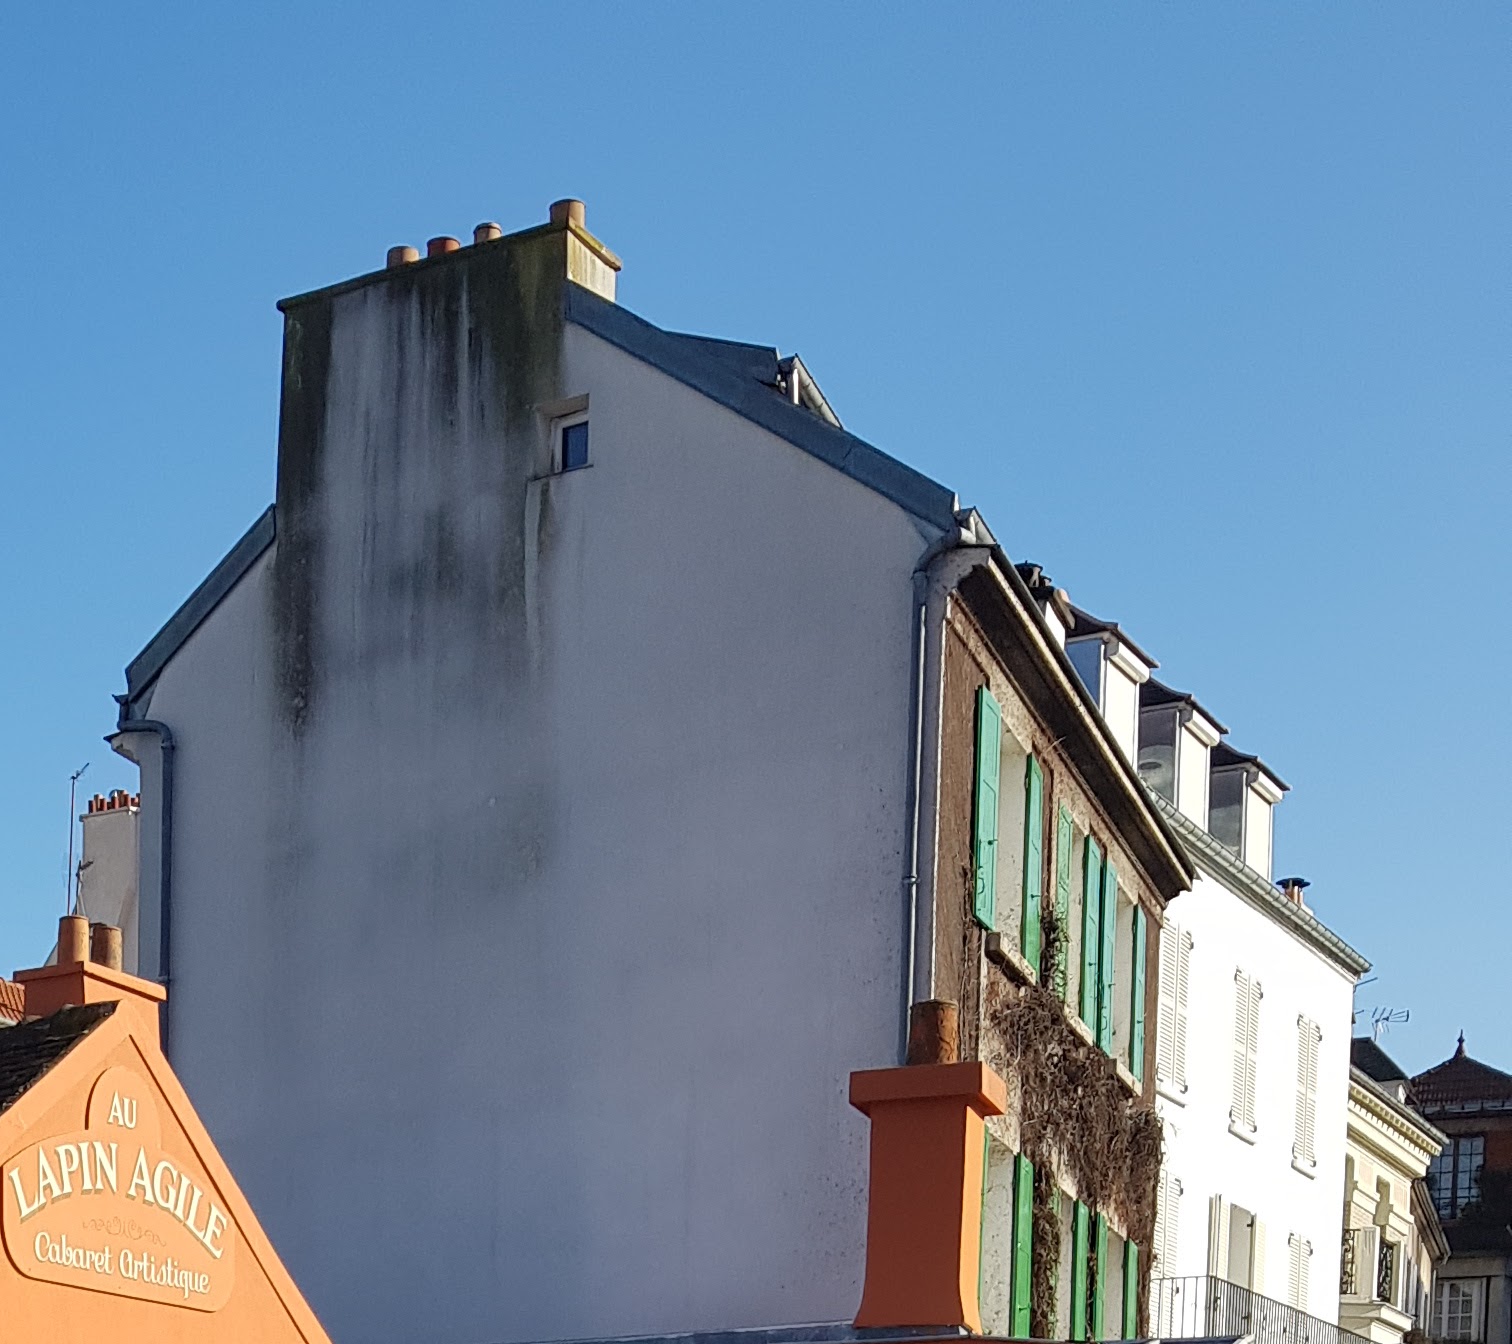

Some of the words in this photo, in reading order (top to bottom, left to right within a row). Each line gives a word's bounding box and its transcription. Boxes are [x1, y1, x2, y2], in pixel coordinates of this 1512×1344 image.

[108, 1090, 137, 1129] AU
[8, 1141, 118, 1222] LAPIN
[126, 1145, 228, 1259] AGILE
[34, 1231, 113, 1275] Cabaret
[119, 1250, 210, 1300] Artistique
